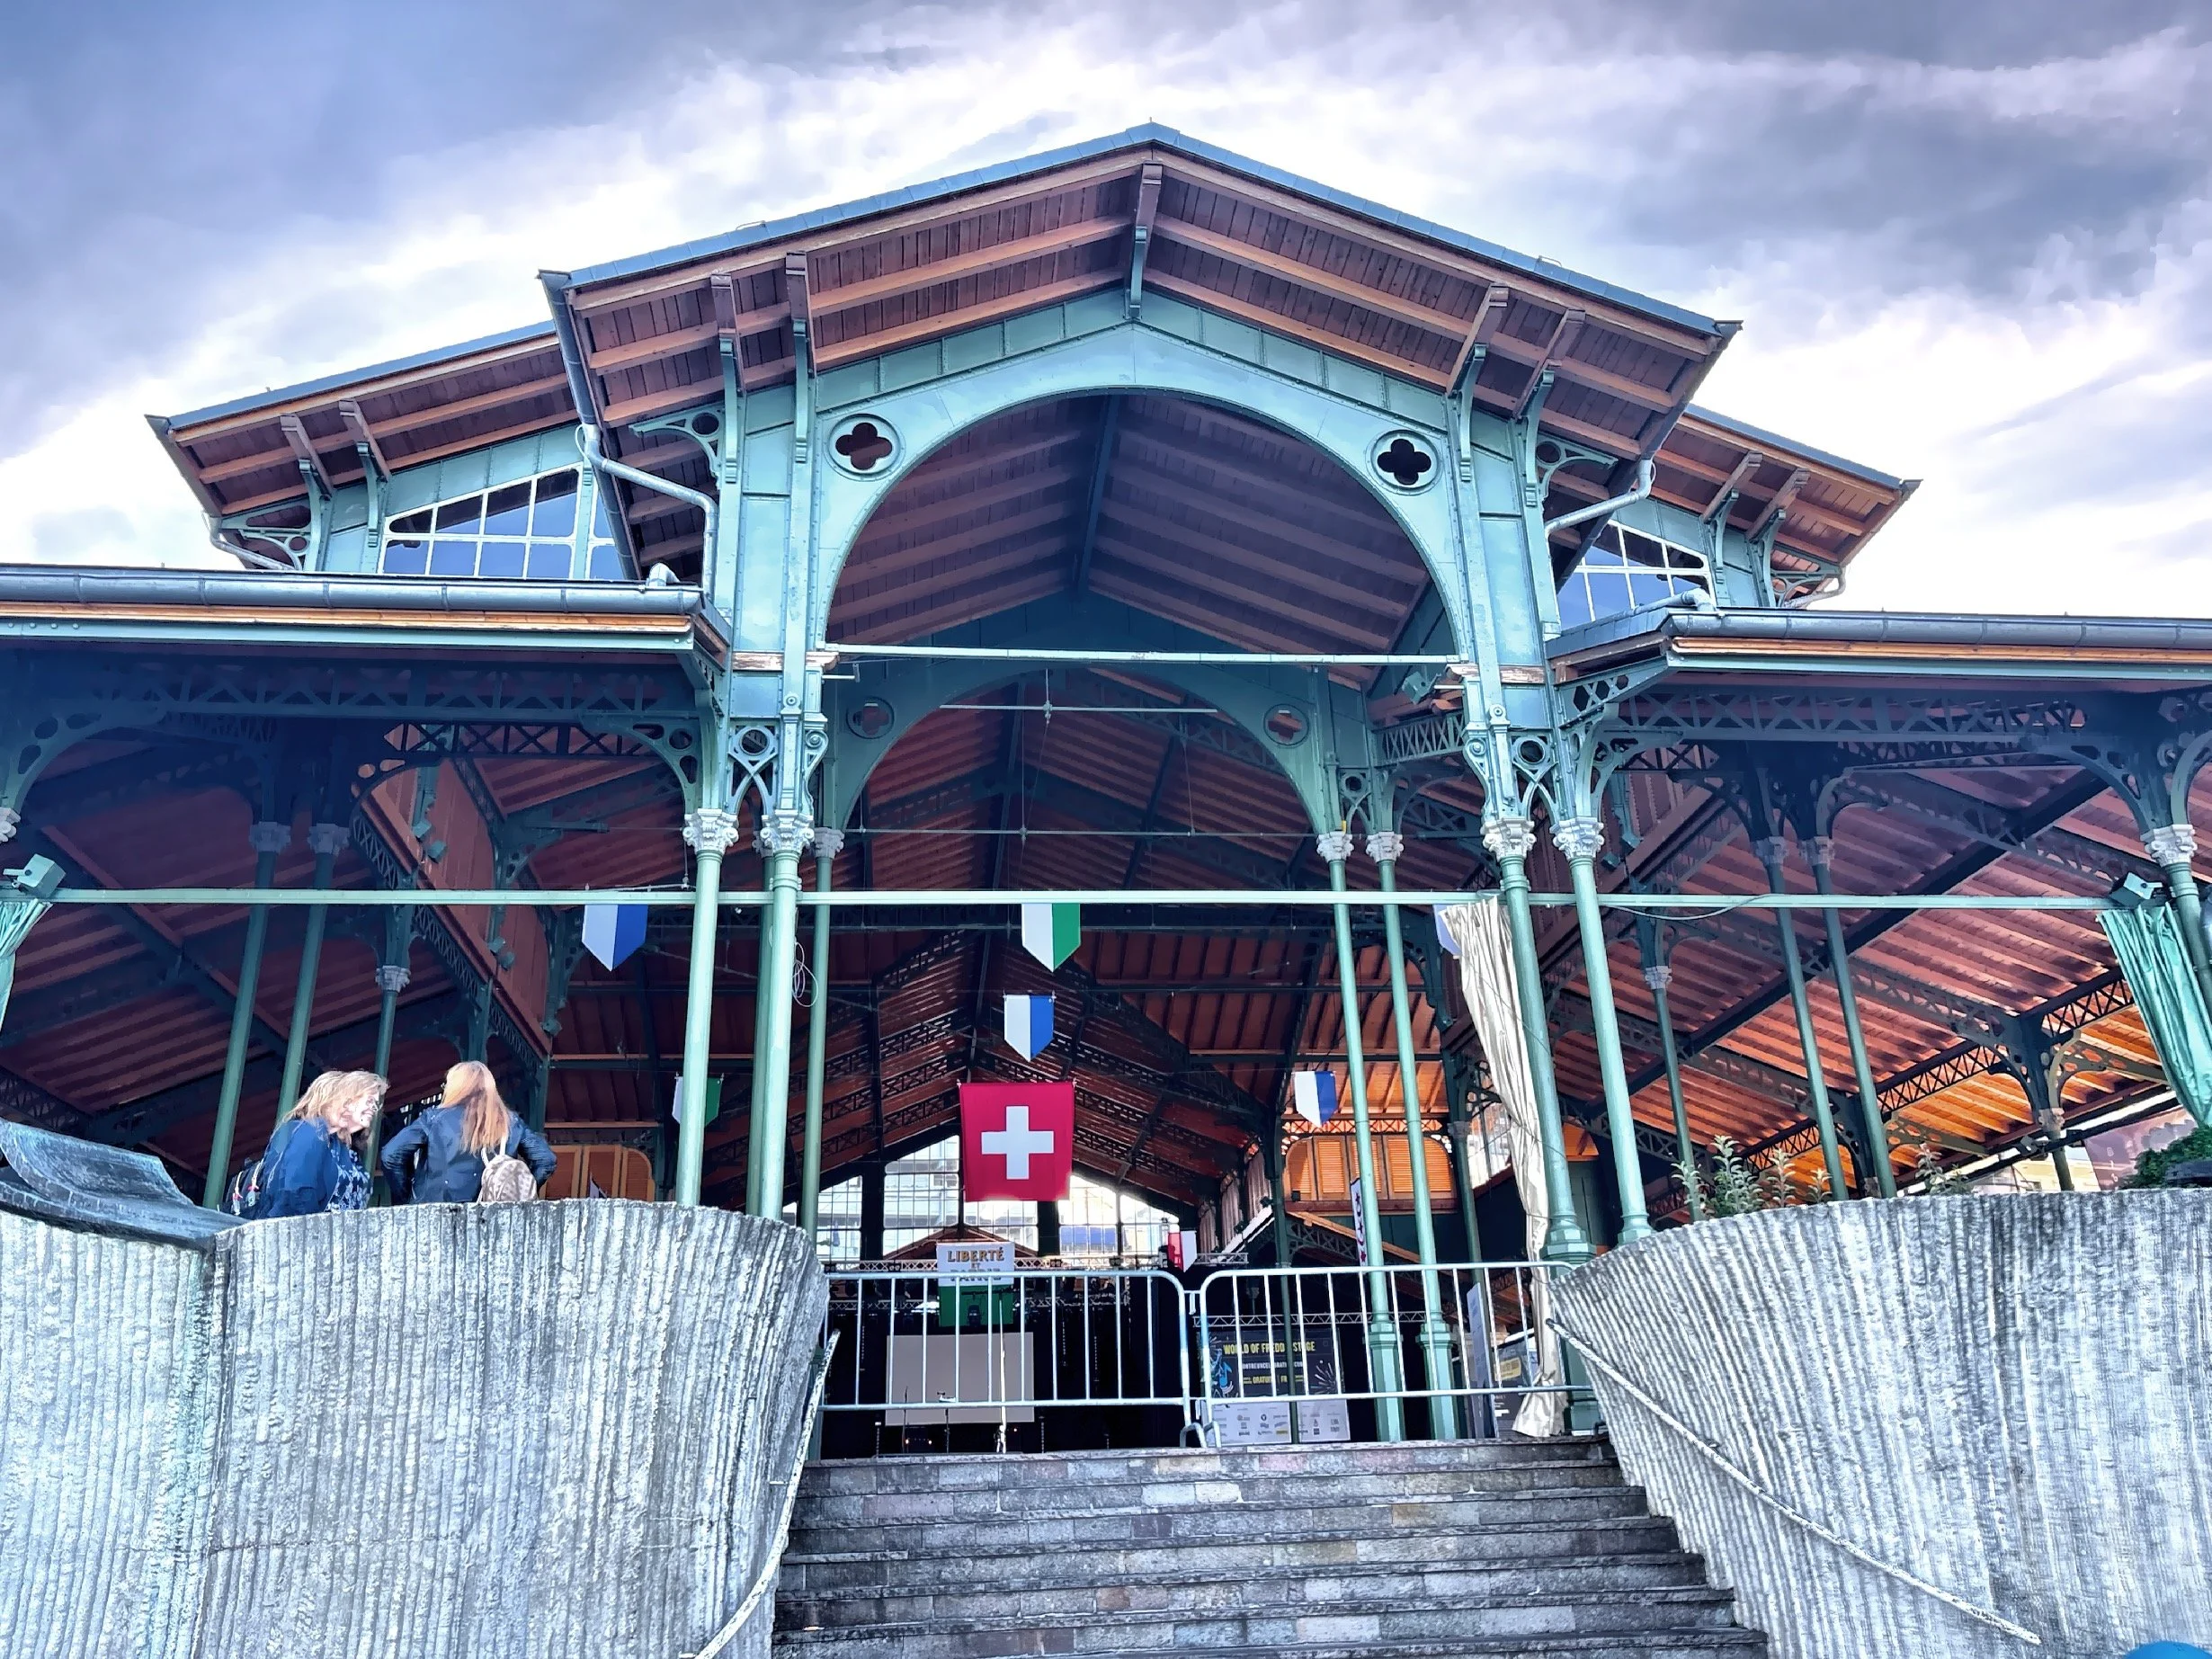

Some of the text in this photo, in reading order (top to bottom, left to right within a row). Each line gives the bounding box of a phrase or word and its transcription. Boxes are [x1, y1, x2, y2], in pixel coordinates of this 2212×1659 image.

[947, 1246, 1005, 1262] LIBERTÉ
[1250, 1342, 1261, 1353] OF
[1292, 1341, 1316, 1352] STGE
